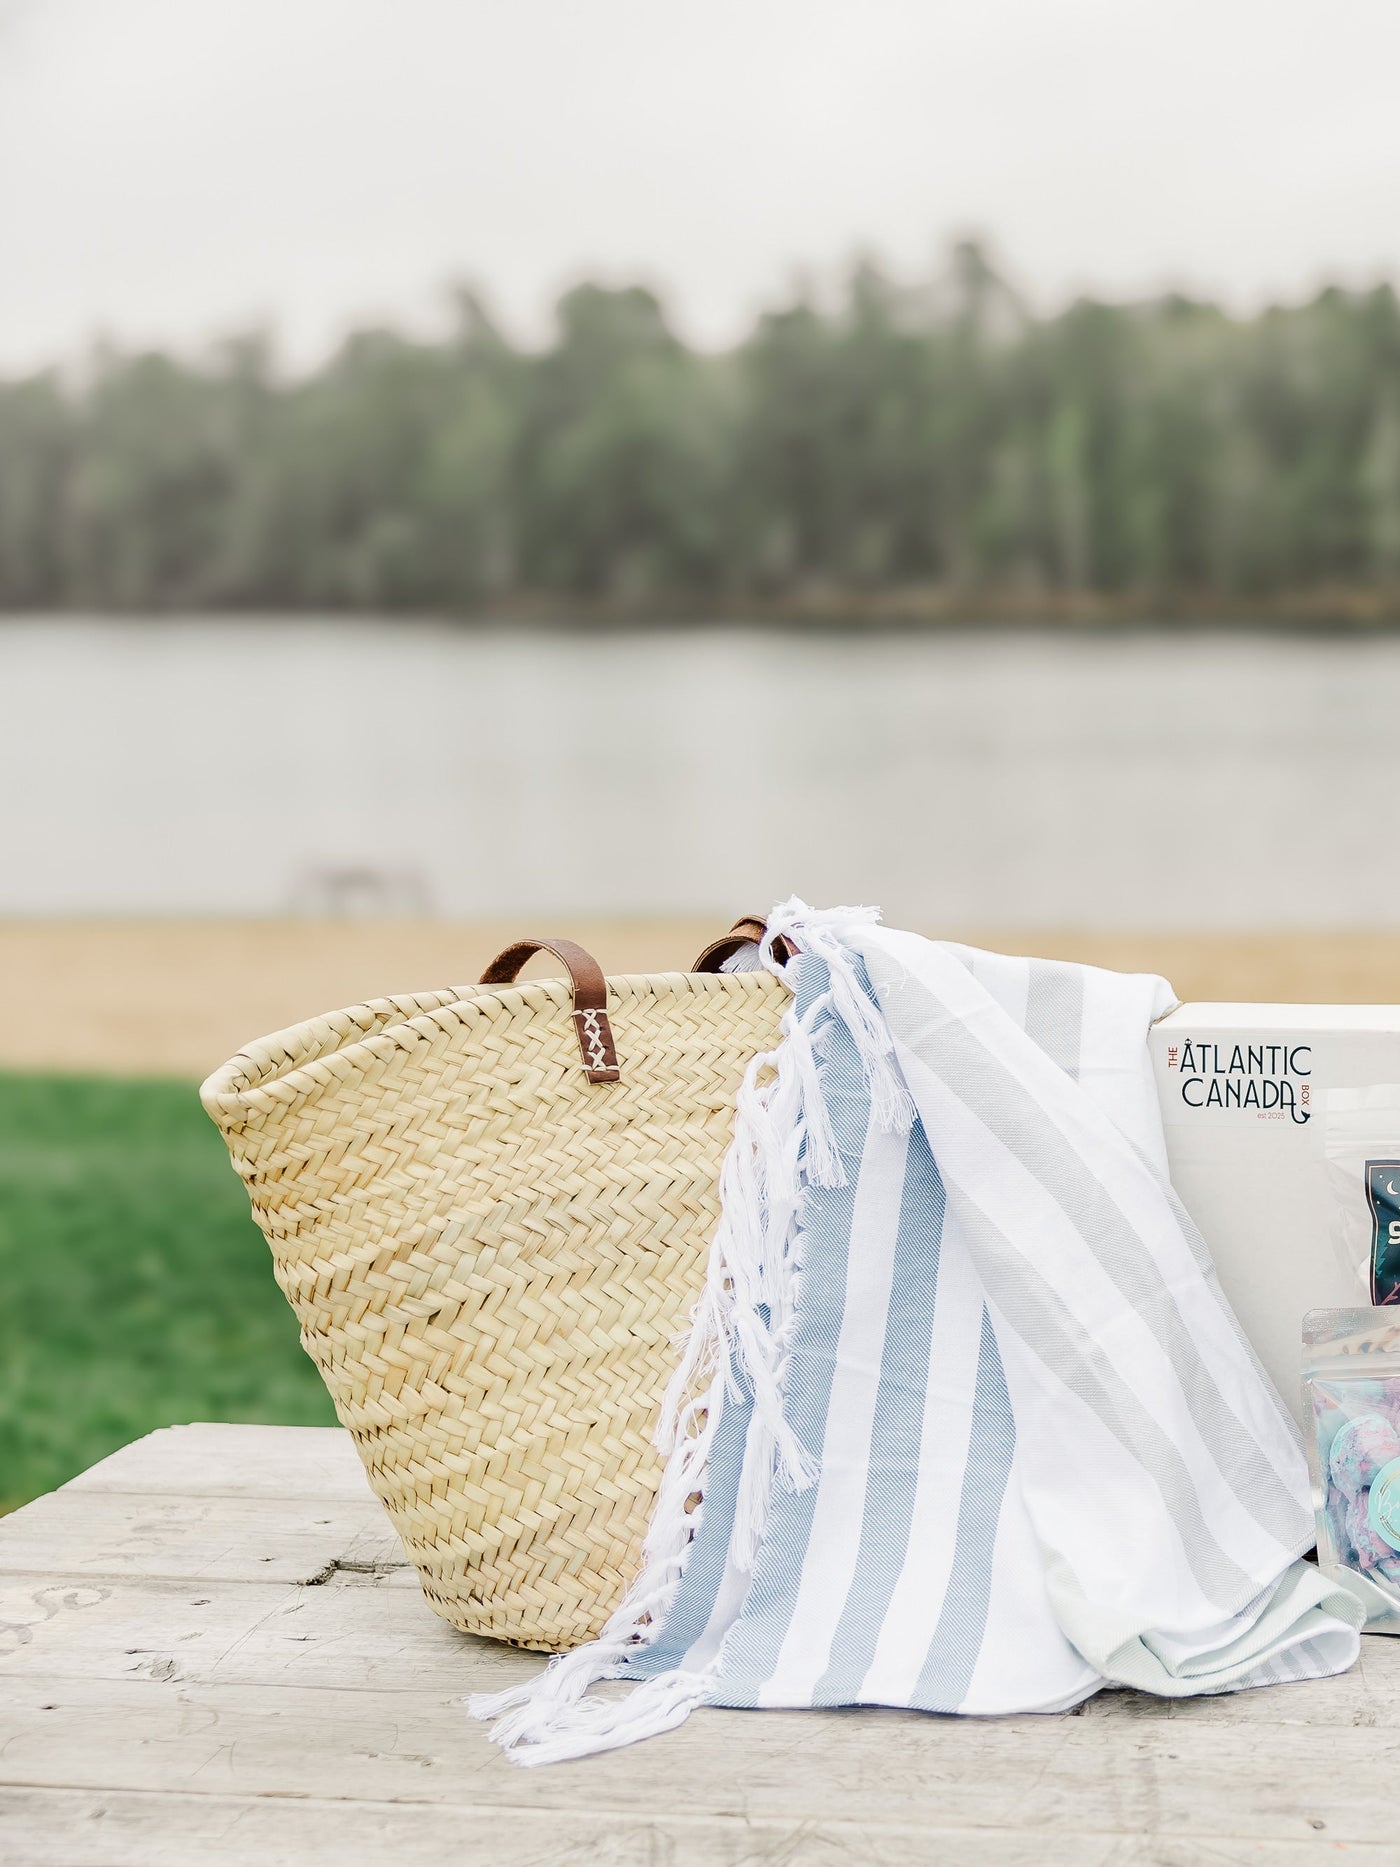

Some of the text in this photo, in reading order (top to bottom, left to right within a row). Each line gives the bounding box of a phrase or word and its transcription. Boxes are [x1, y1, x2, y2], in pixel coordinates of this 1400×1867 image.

[1168, 1047, 1178, 1068] THE
[1179, 1039, 1312, 1076] ATLANTIC
[1181, 1078, 1311, 1124] CANADA
[1301, 1084, 1310, 1106] BOX
[1267, 1112, 1286, 1120] 2025
